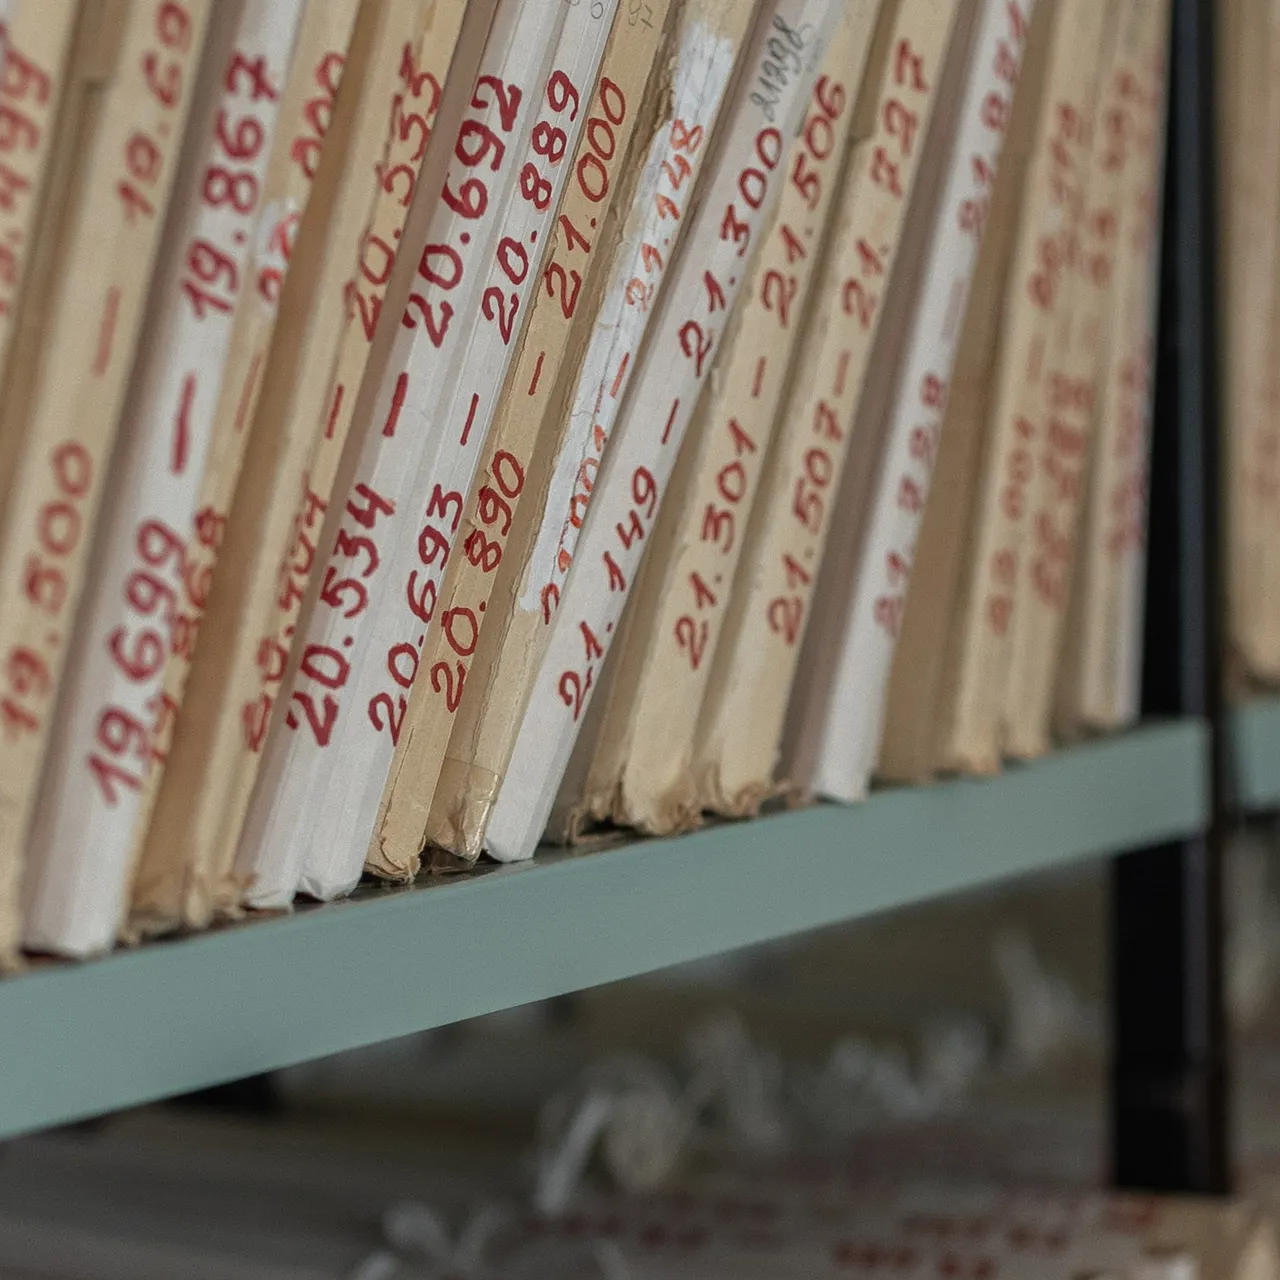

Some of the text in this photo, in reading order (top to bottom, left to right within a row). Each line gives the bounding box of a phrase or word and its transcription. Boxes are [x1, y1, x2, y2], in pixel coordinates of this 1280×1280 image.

[88, 519, 186, 805] 19.699
[181, 51, 279, 320] 19.867
[287, 484, 392, 747] 20.534
[404, 76, 521, 346] 20.692
[369, 484, 463, 745] 20.693
[483, 70, 580, 345] 20.889
[431, 450, 524, 712] 20.890
[543, 77, 626, 318] 21.000
[560, 465, 656, 721] 21.149
[678, 127, 783, 376] 21.300
[626, 120, 704, 313] 21.148
[674, 418, 758, 669] 21.301
[761, 74, 846, 327] 21.506
[768, 399, 844, 645] 21.507
